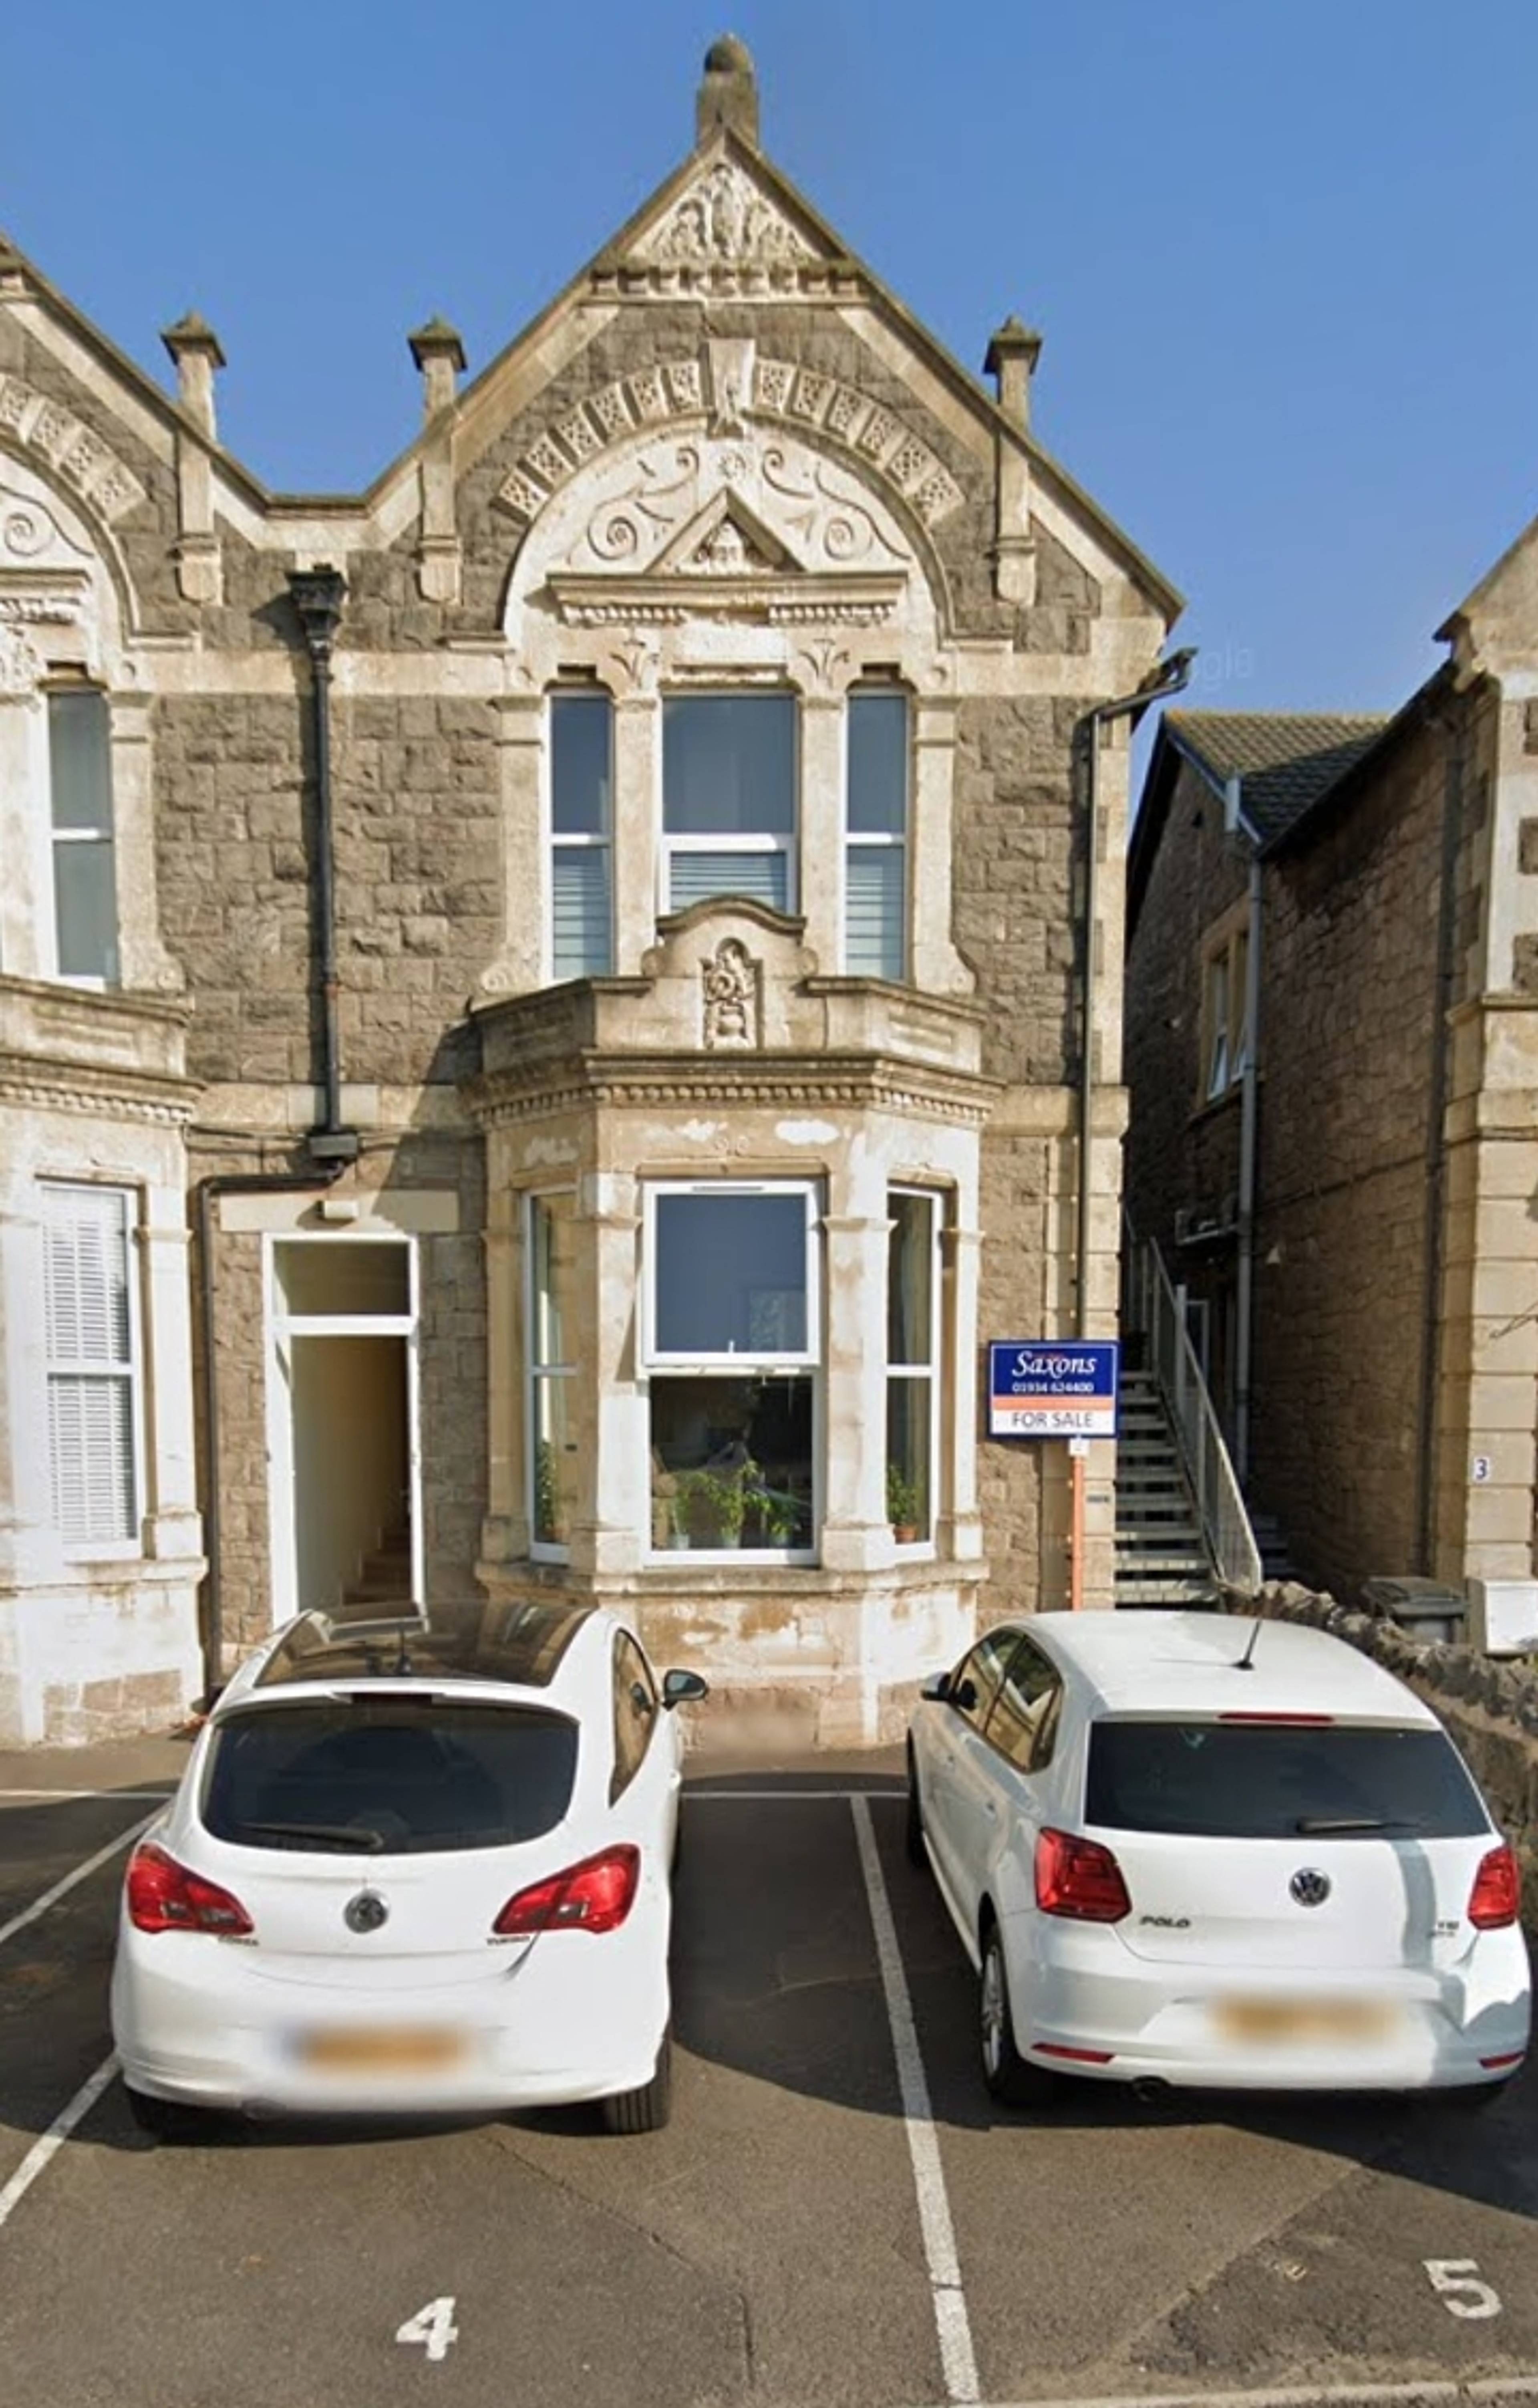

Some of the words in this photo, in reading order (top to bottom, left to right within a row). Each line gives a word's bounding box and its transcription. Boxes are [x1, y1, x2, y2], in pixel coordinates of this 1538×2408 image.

[1012, 1350, 1097, 1379] Saxons
[1012, 1412, 1047, 1427] FOR
[1052, 1412, 1093, 1427] SALE
[1476, 1459, 1487, 1480] 3
[1140, 1916, 1191, 1929] POLO
[1422, 2258, 1502, 2318] 5
[396, 2296, 458, 2360] 4
